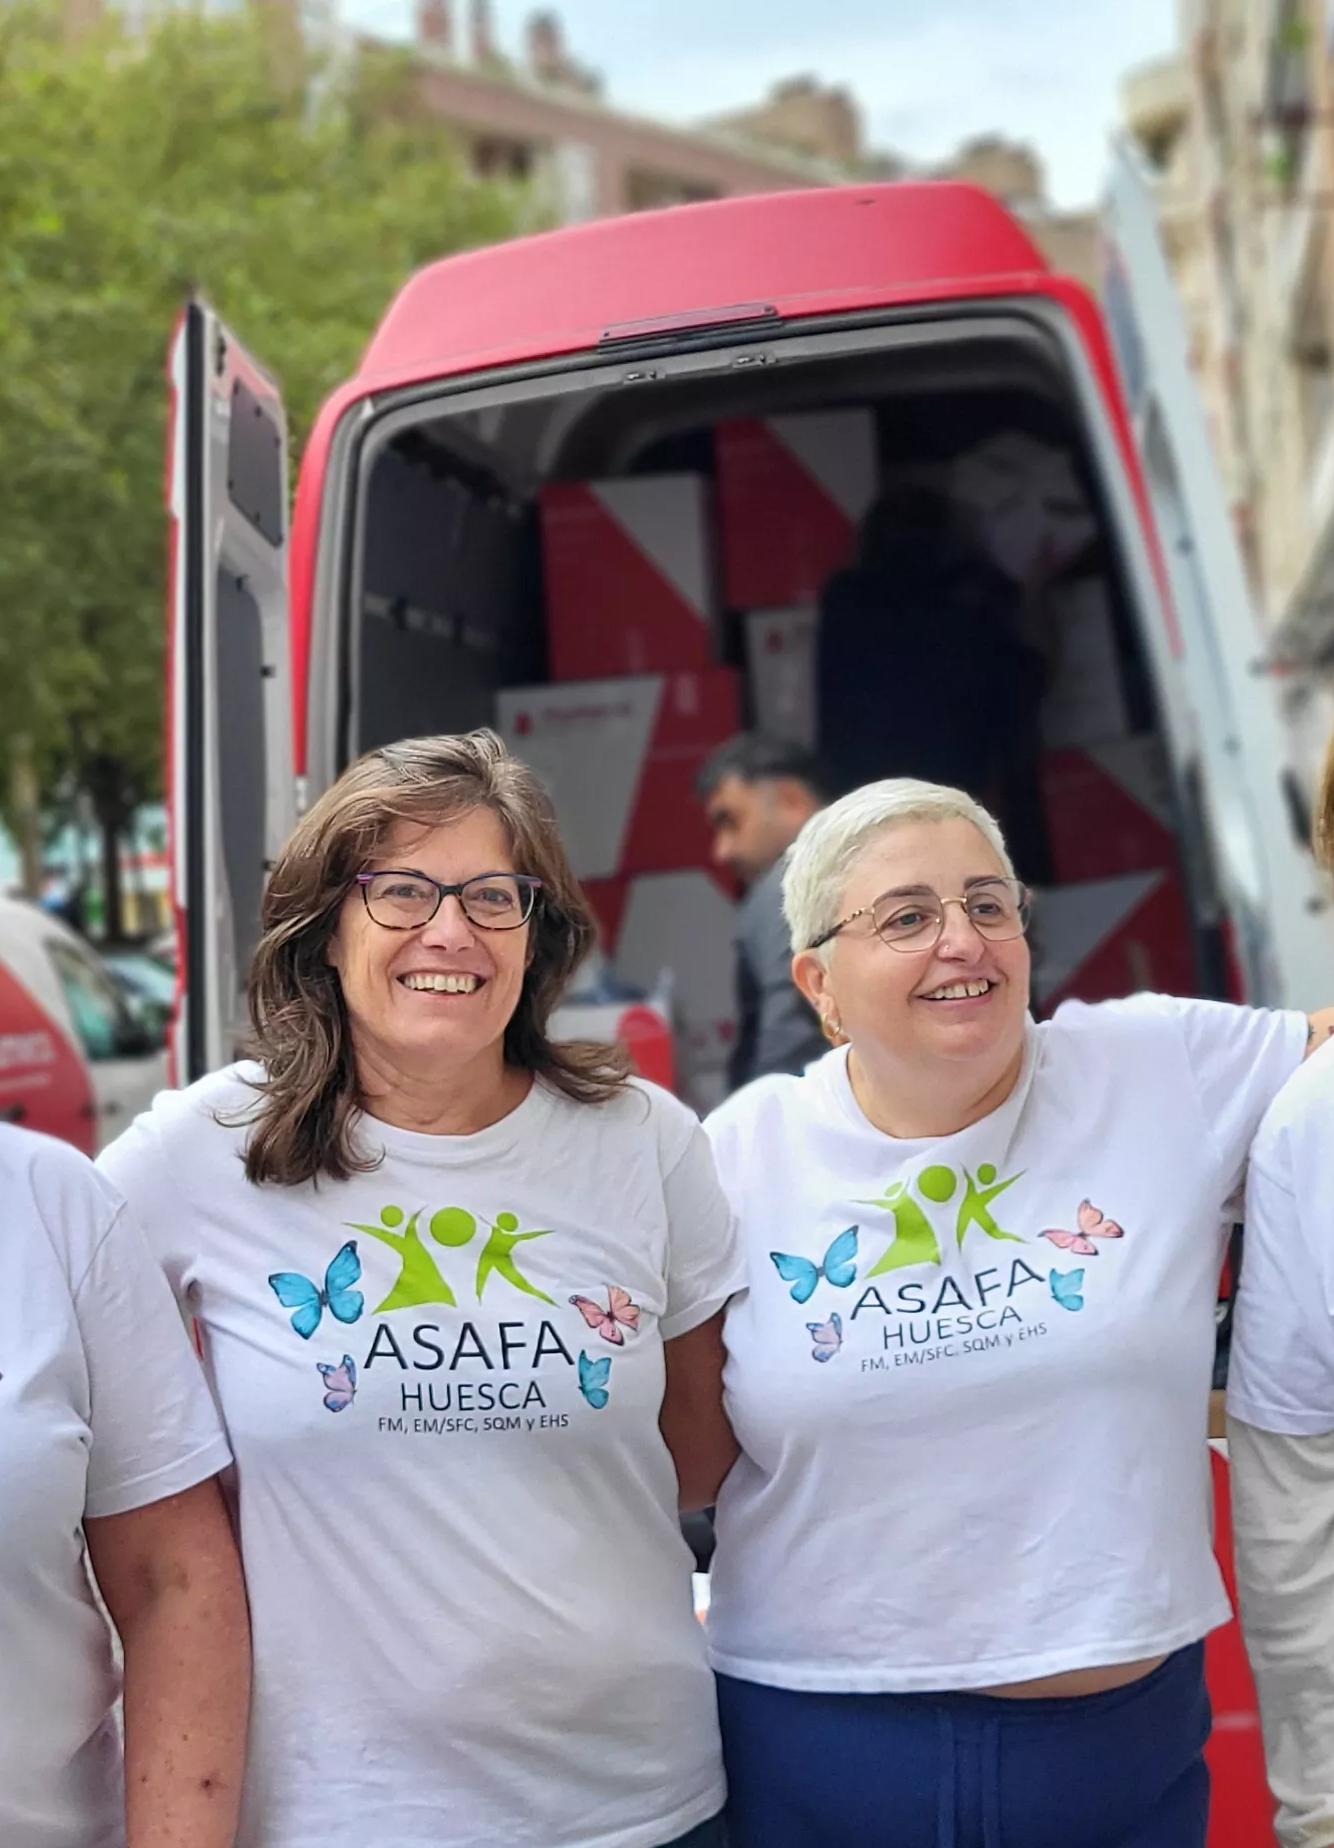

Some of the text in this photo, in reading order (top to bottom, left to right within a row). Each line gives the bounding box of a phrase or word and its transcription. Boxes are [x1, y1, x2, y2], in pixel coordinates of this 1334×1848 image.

[850, 1258, 1046, 1320] ASAFA
[364, 1321, 575, 1370] ASAFA
[861, 1357, 889, 1372] FM,
[964, 1335, 1000, 1352] SQM
[1005, 1334, 1013, 1347] y
[1019, 1322, 1047, 1340] EHS
[883, 1306, 1022, 1349] HUESCA
[401, 1381, 546, 1411] HUESCA
[378, 1414, 569, 1434] FM, EM/SFC, SQM y EHS
